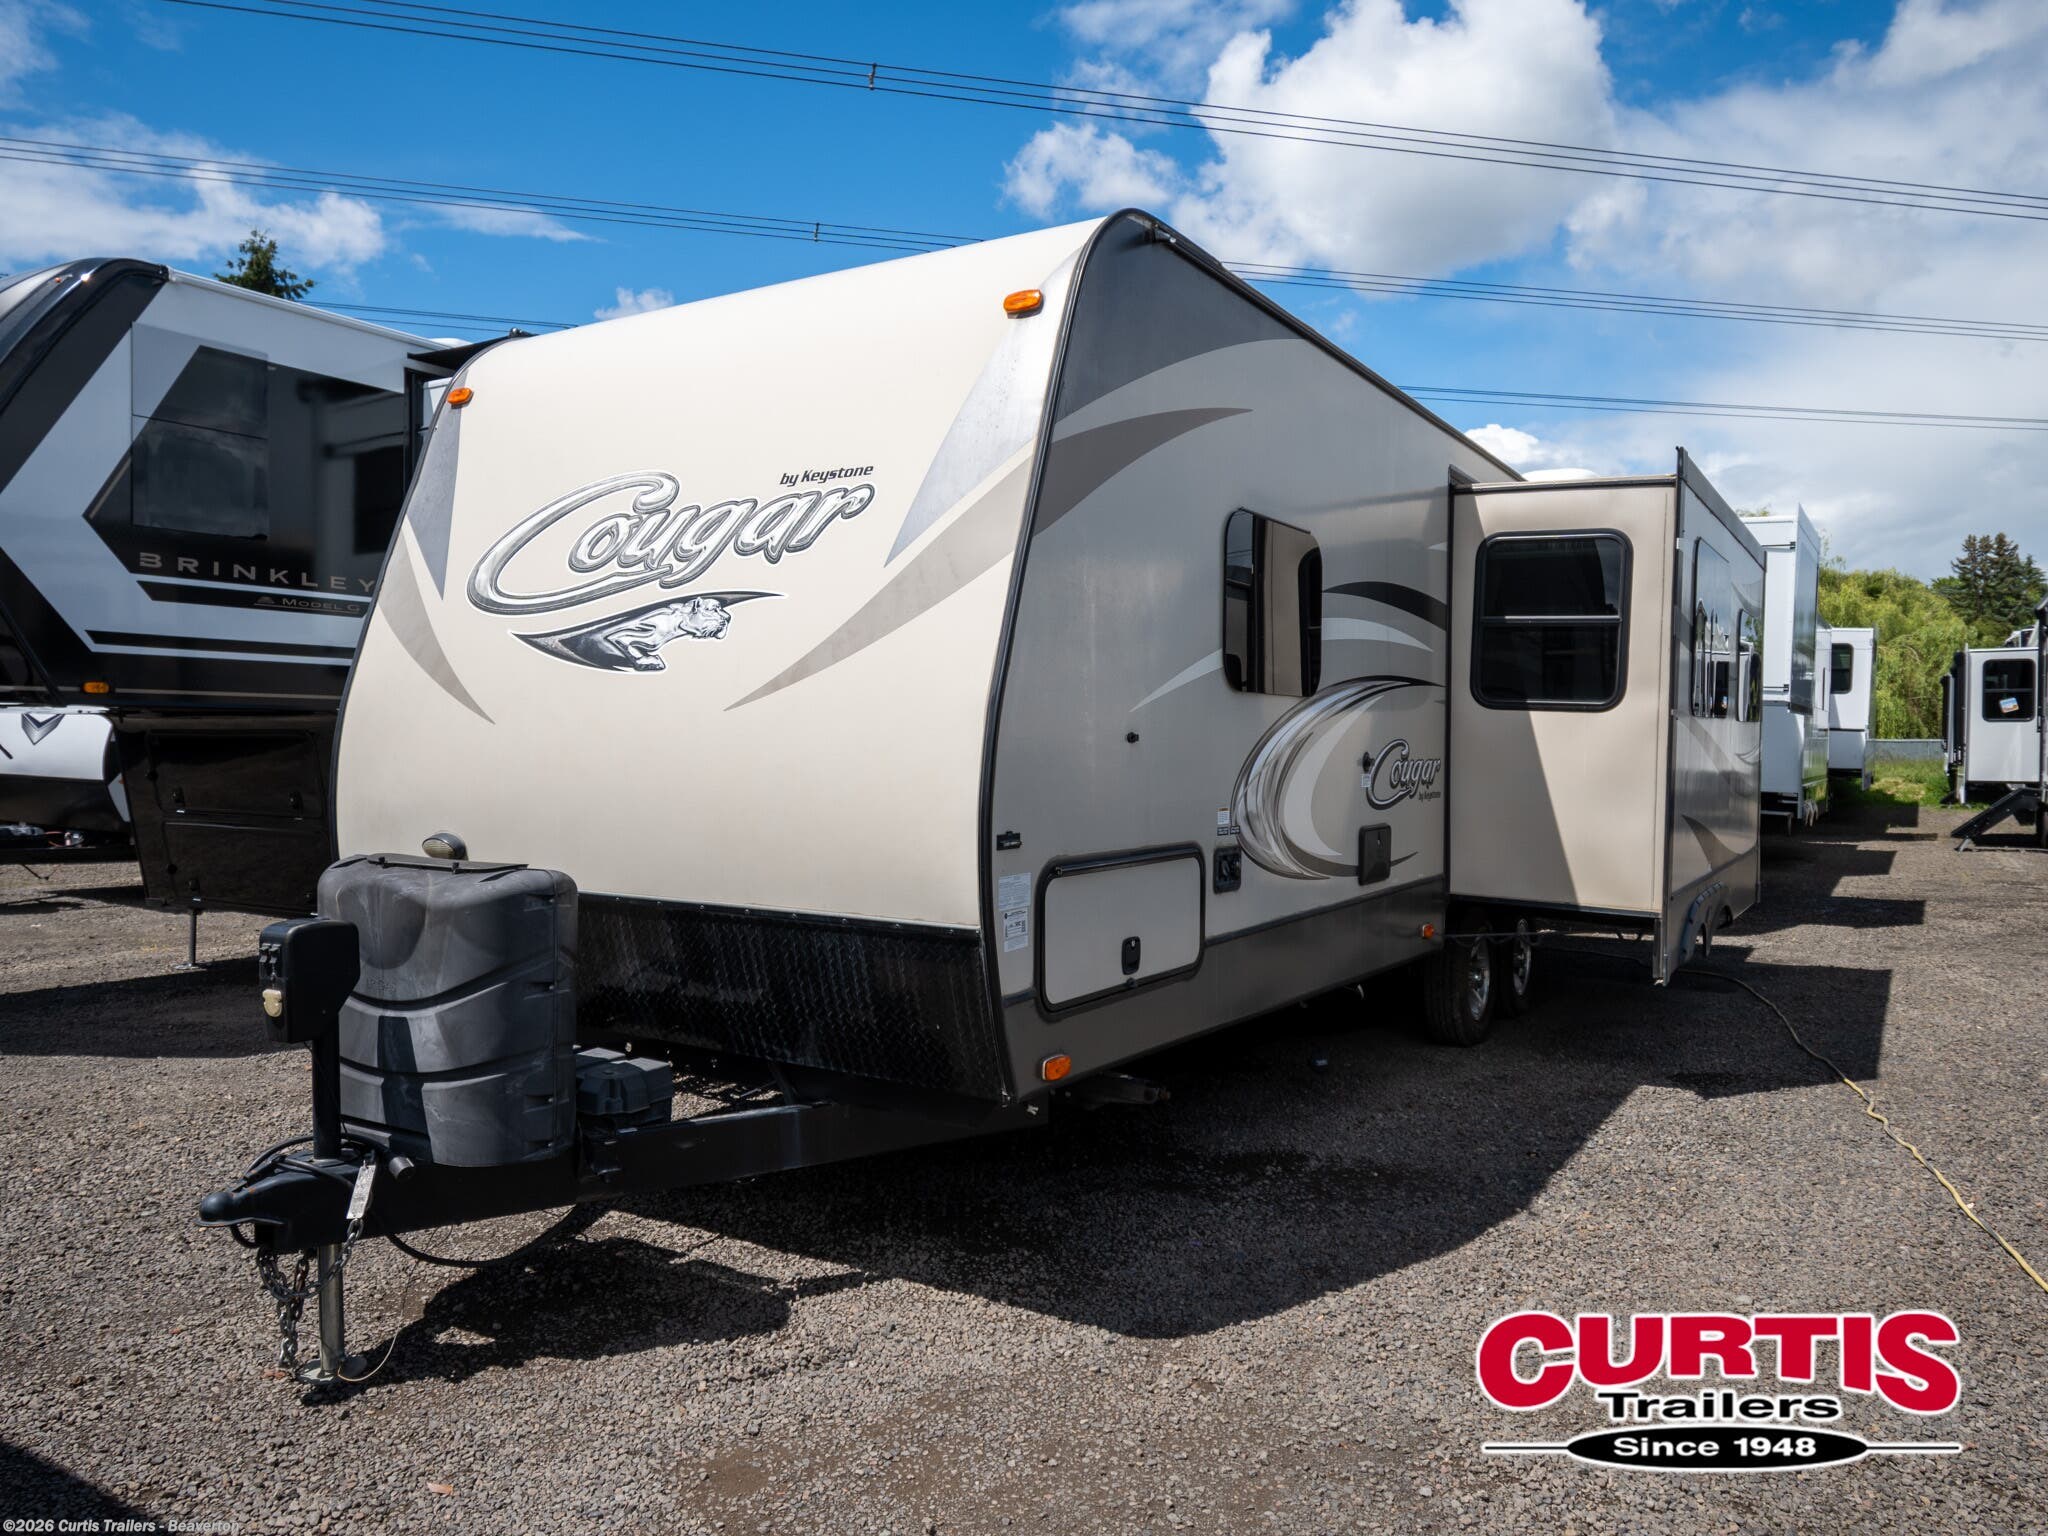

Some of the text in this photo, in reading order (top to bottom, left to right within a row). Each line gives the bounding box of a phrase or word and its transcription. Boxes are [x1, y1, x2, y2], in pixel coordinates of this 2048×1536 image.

[779, 466, 874, 487] by Keystone
[139, 551, 375, 593] BRINKLEY
[467, 471, 876, 616] Cougar
[1366, 738, 1441, 811] Cougar
